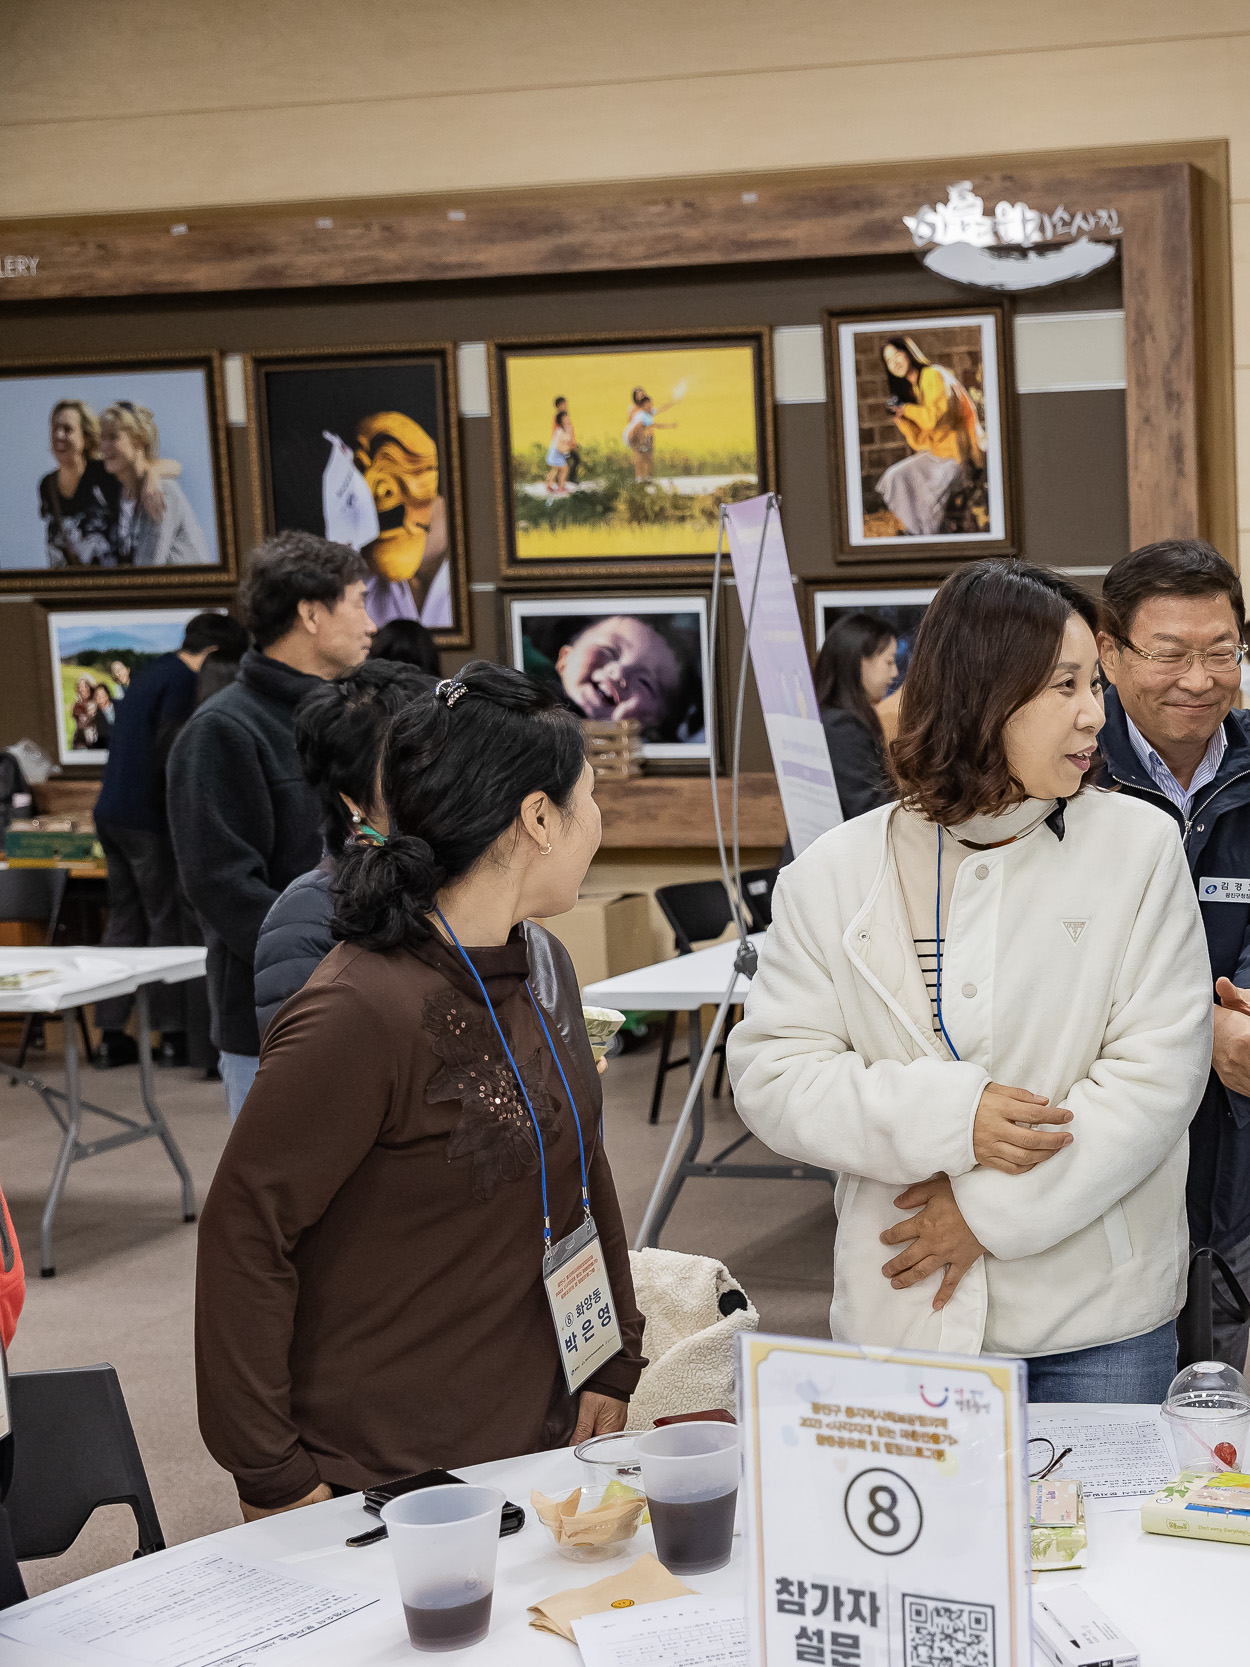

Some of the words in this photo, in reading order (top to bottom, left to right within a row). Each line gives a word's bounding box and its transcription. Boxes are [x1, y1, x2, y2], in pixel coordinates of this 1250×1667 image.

[575, 1288, 601, 1318] 화양동
[775, 1576, 880, 1628] 참가자
[794, 1625, 862, 1667] 설문
